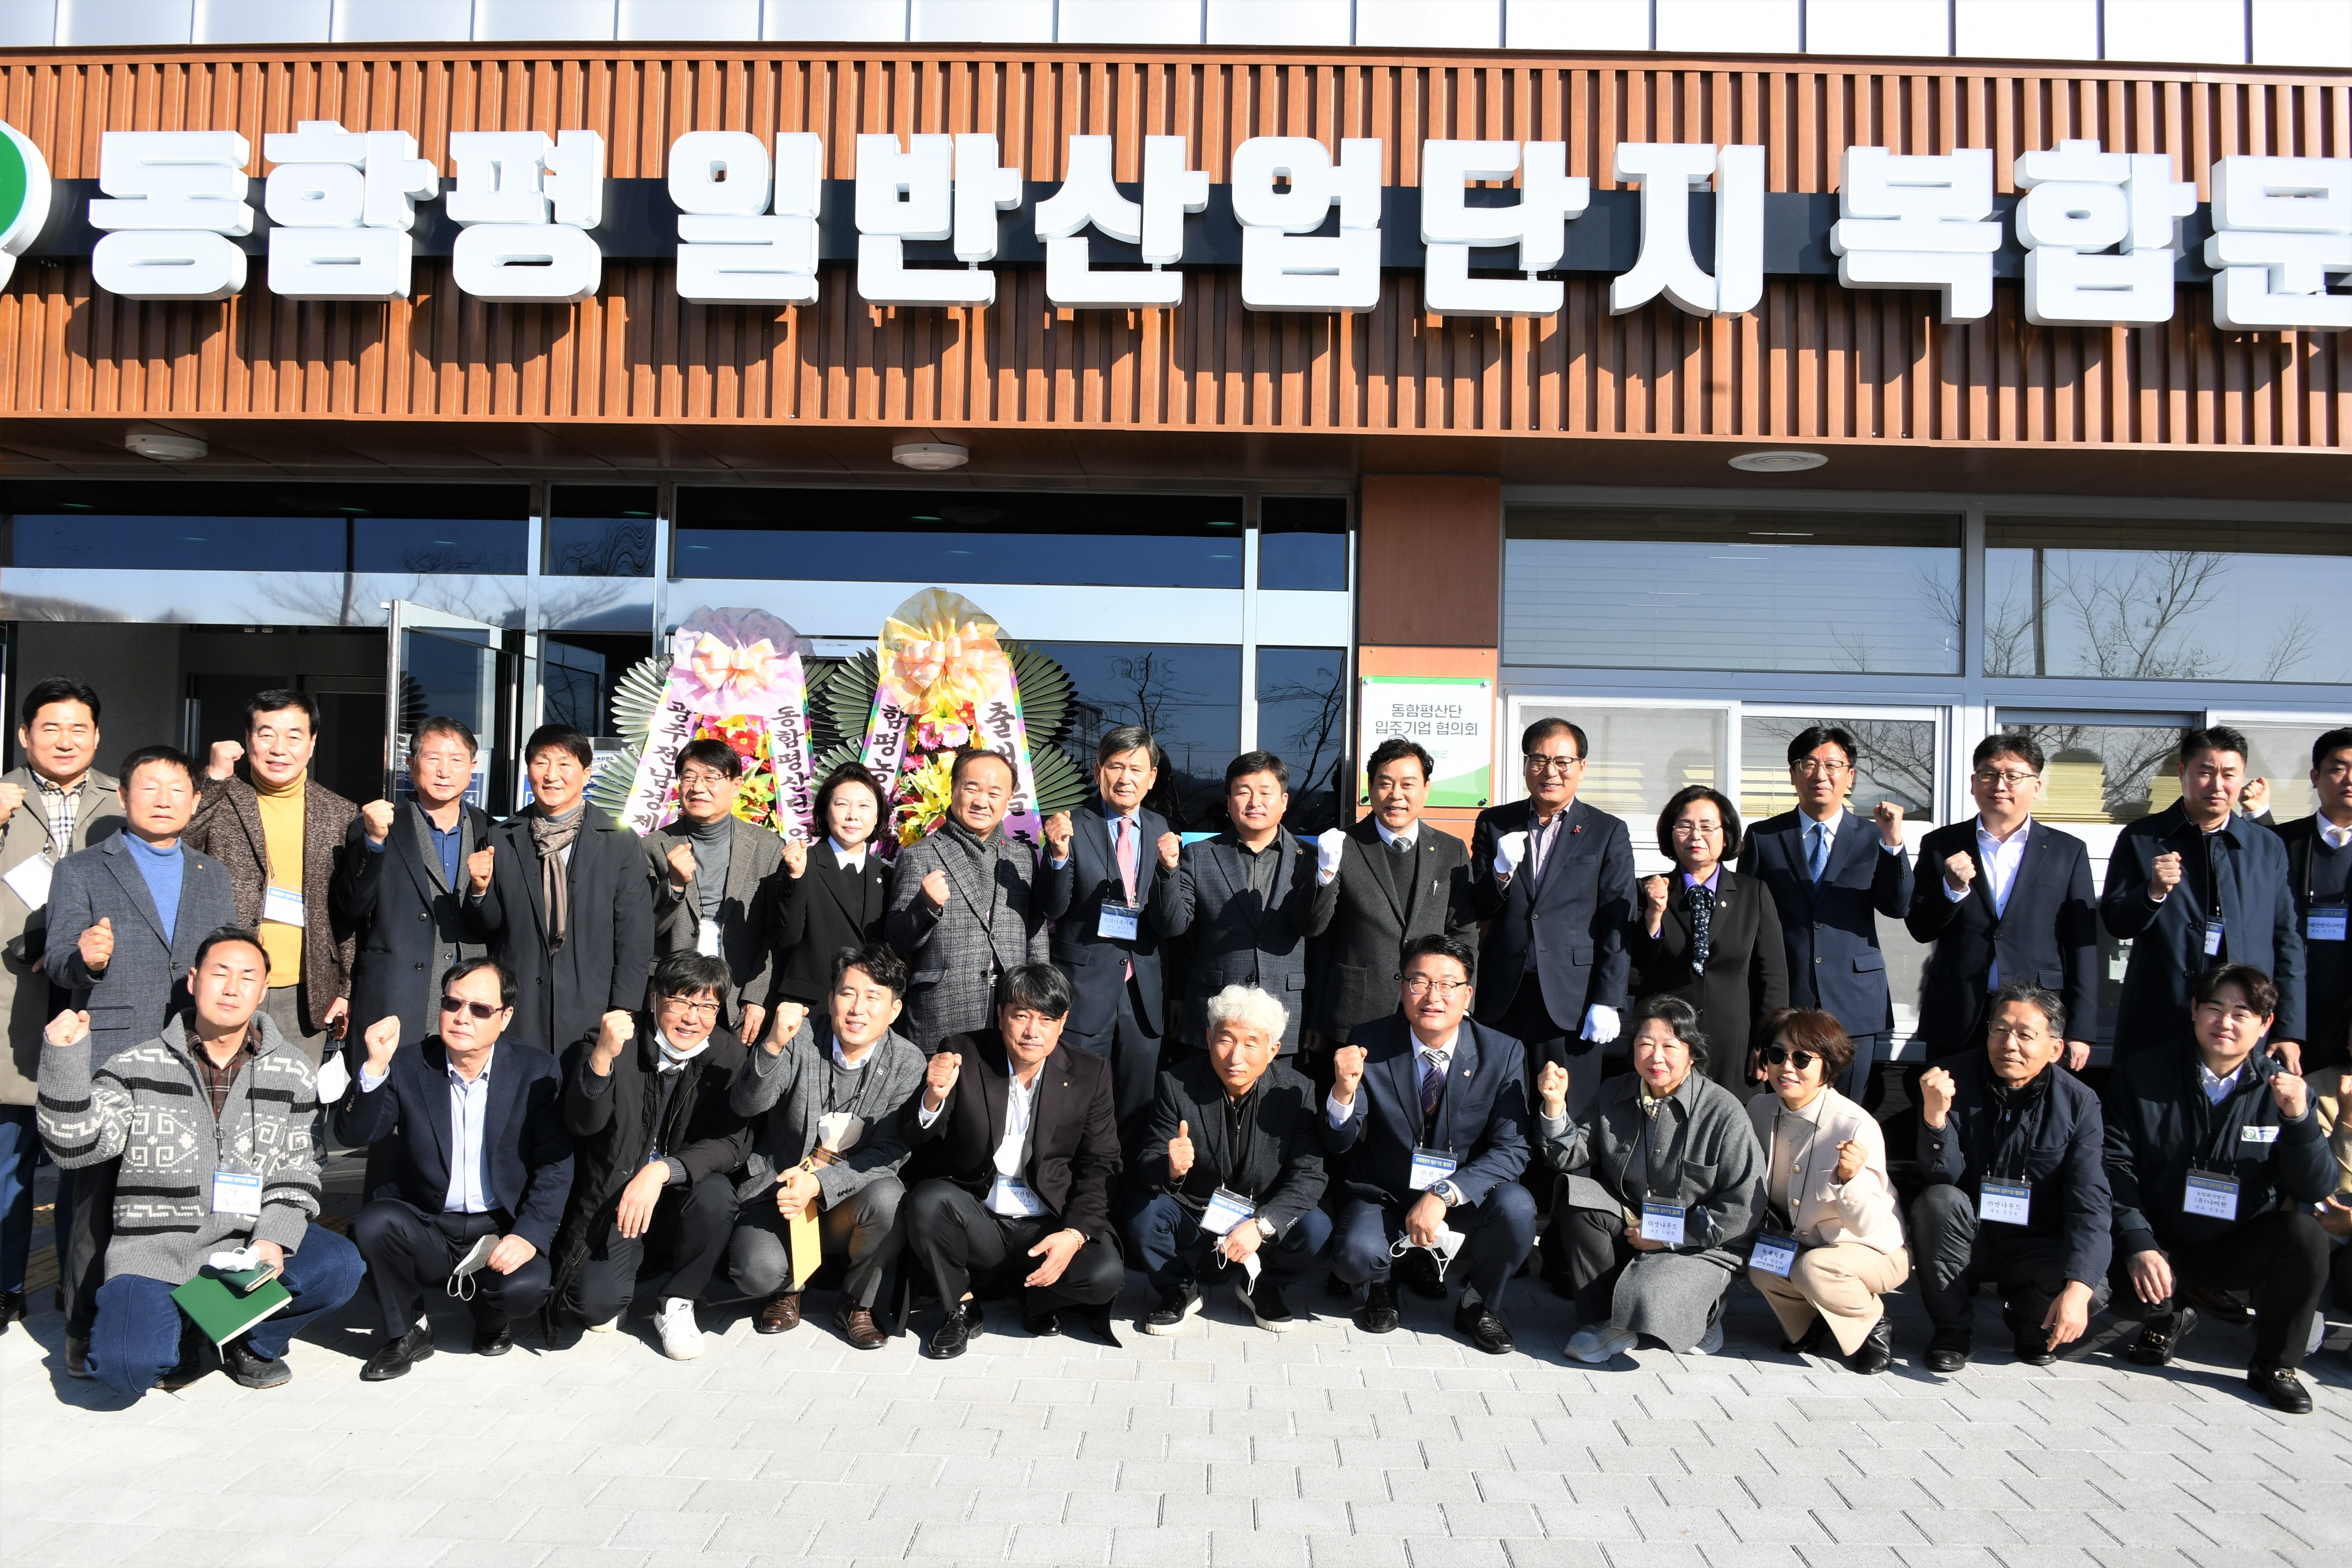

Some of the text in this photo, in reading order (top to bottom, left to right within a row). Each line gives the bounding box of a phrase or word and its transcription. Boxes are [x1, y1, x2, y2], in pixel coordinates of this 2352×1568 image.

[89, 120, 2352, 332] 동함평 일반산업단지 복합문
[1391, 704, 1462, 718] 동함평산단
[1375, 721, 1477, 736] 입주기업 협의회
